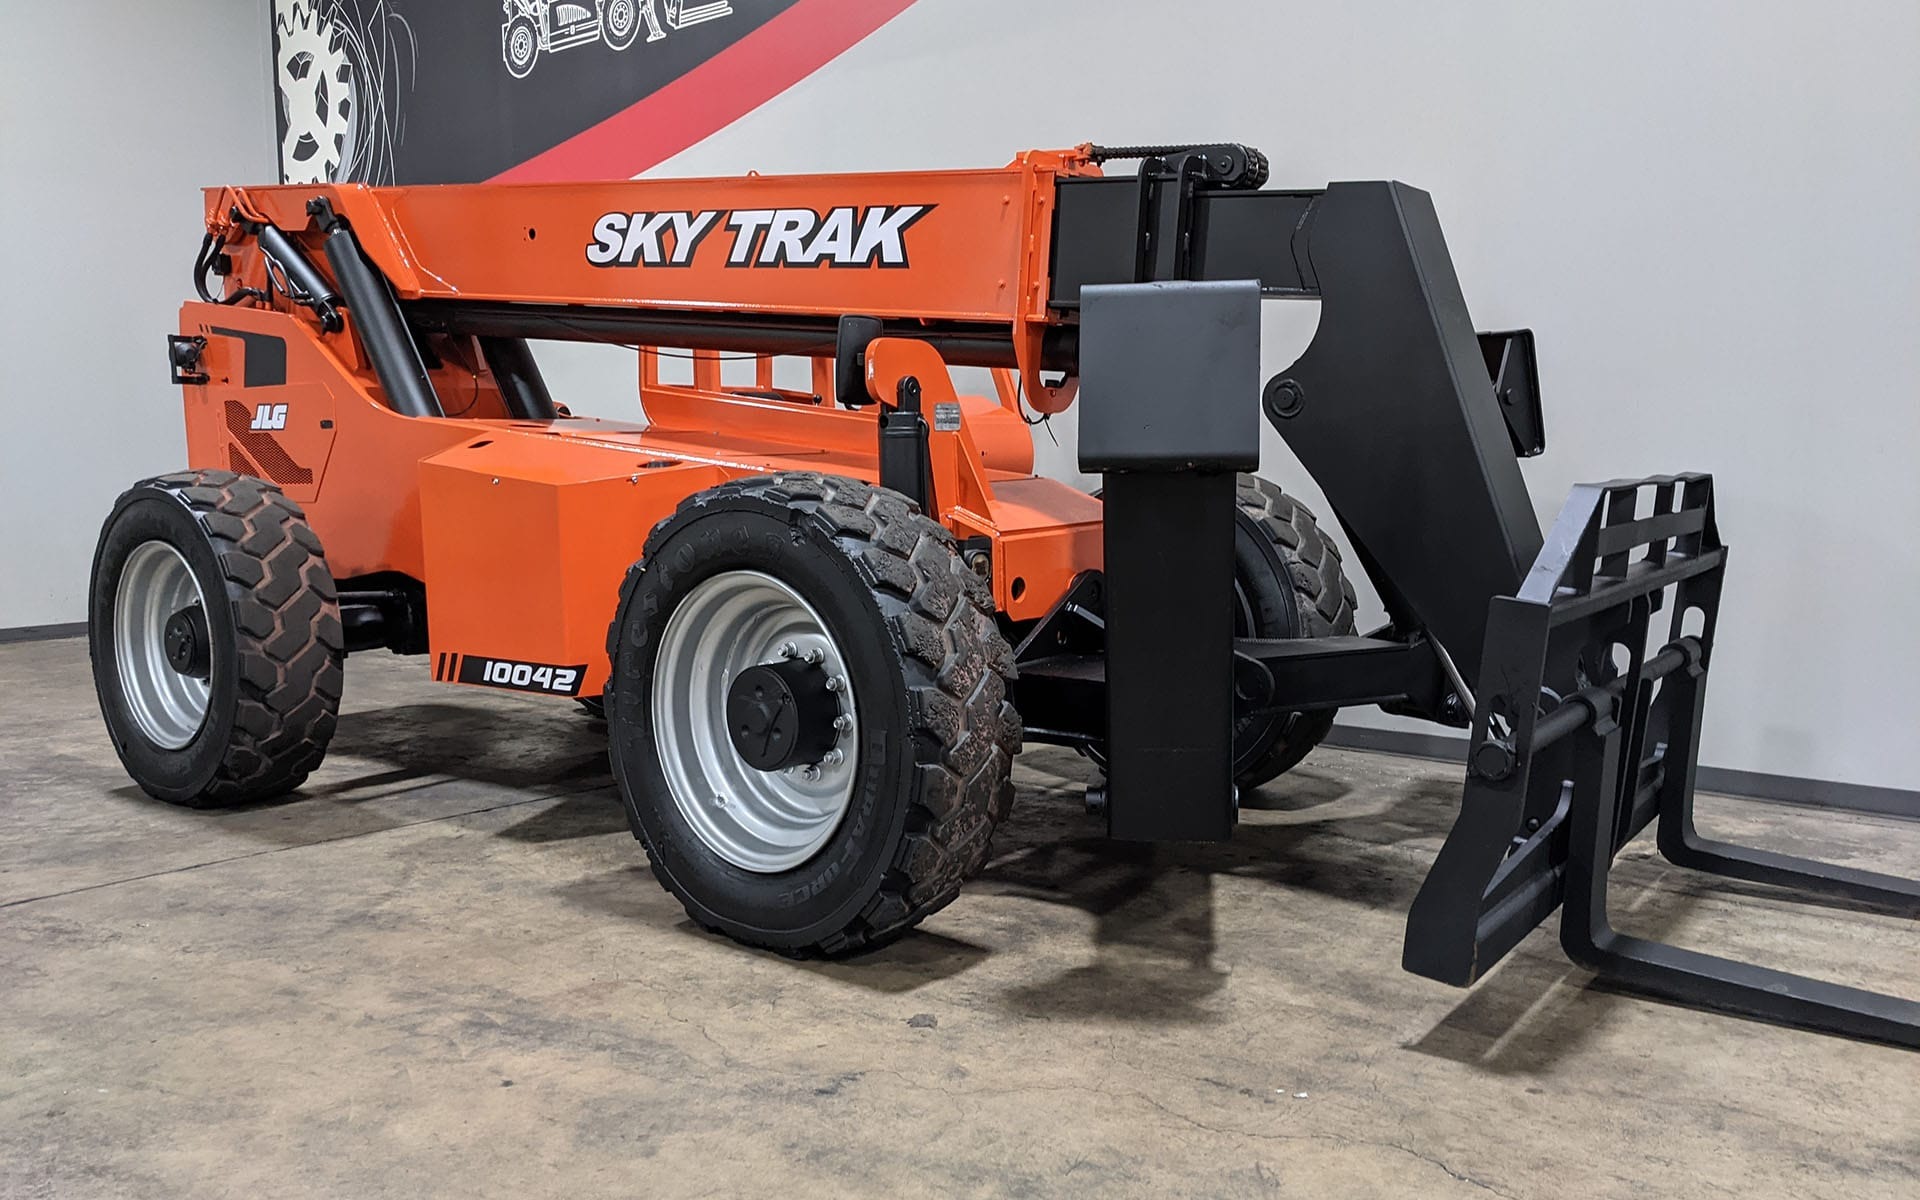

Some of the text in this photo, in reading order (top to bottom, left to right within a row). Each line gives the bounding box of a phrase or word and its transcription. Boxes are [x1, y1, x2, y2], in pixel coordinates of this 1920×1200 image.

[585, 203, 939, 268] SKY TRAK
[250, 403, 289, 431] JLG
[482, 660, 577, 692] 10042
